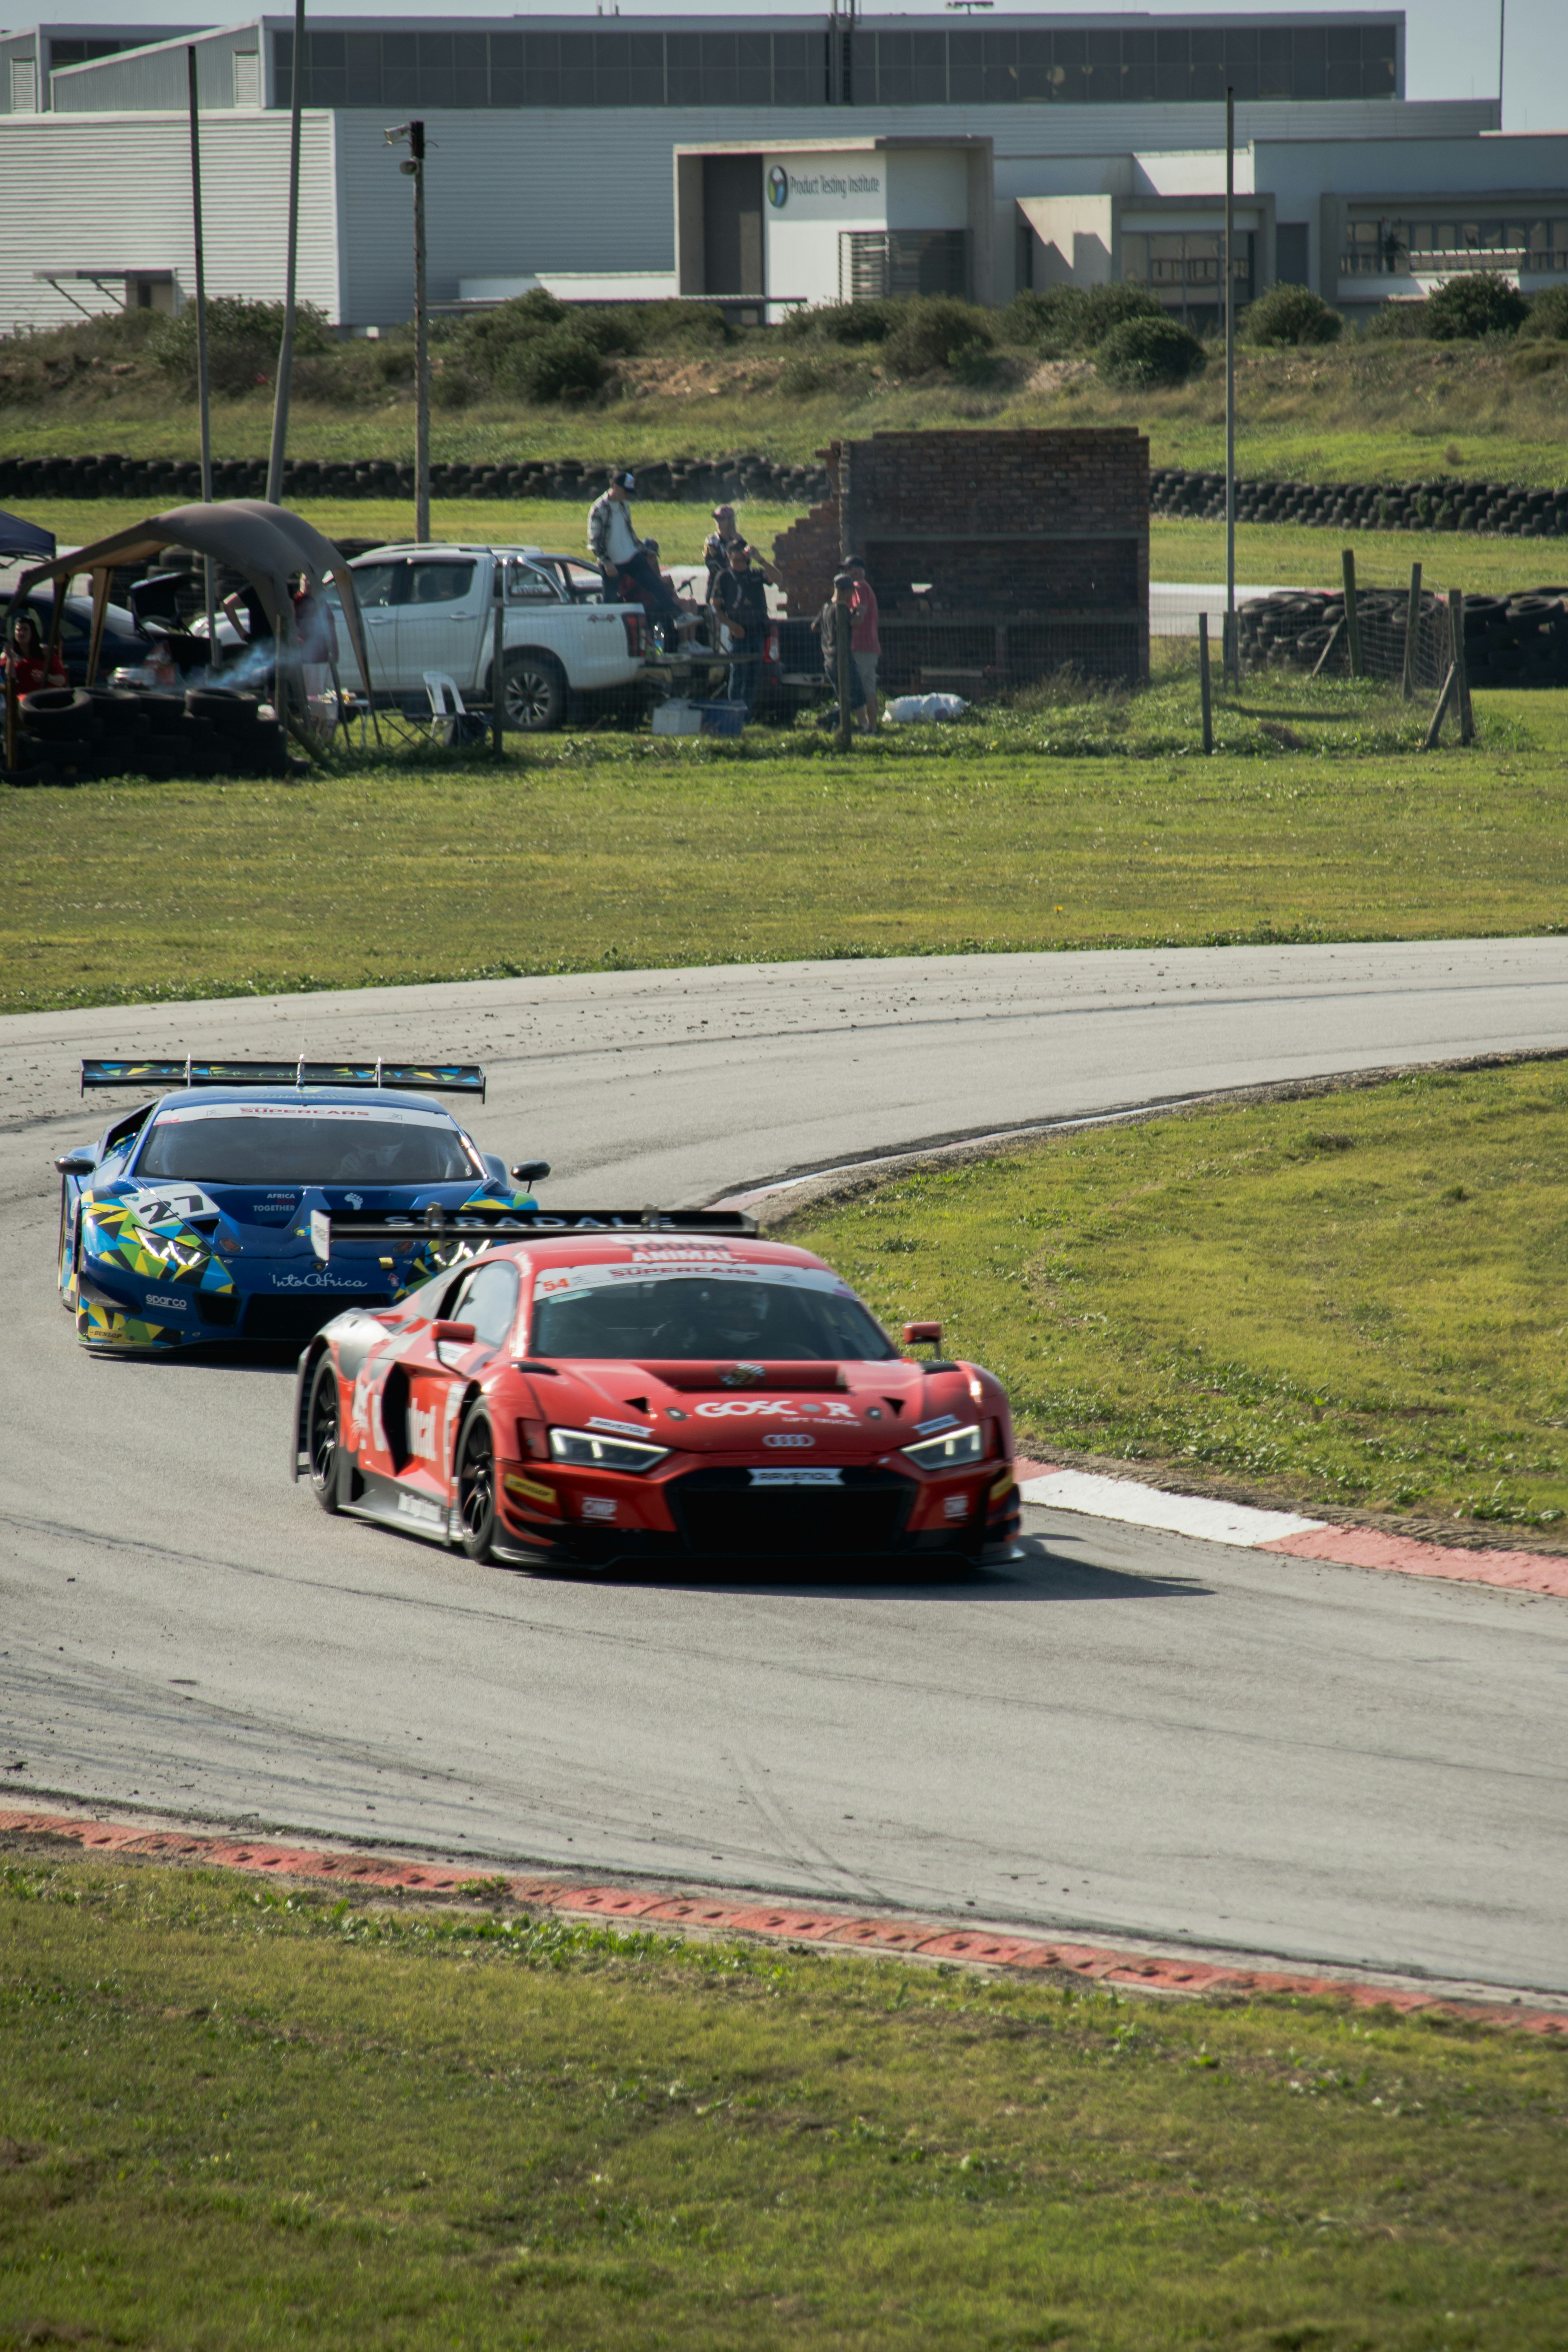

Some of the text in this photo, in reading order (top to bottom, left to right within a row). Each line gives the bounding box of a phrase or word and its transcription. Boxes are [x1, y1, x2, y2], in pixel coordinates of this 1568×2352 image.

[788, 174, 880, 199] Product Testing Institute
[139, 1194, 204, 1225] 27
[384, 1216, 676, 1227] STRADALE
[607, 1236, 725, 1244] ONE
[622, 1243, 731, 1252] TOUGH
[610, 1267, 759, 1277] SUPERCARS
[542, 1278, 570, 1292] 54
[145, 1294, 187, 1309] sparco
[94, 1330, 122, 1339] DUNLOP
[758, 1472, 834, 1481] RAVENOL
[581, 1501, 618, 1516] OMP
